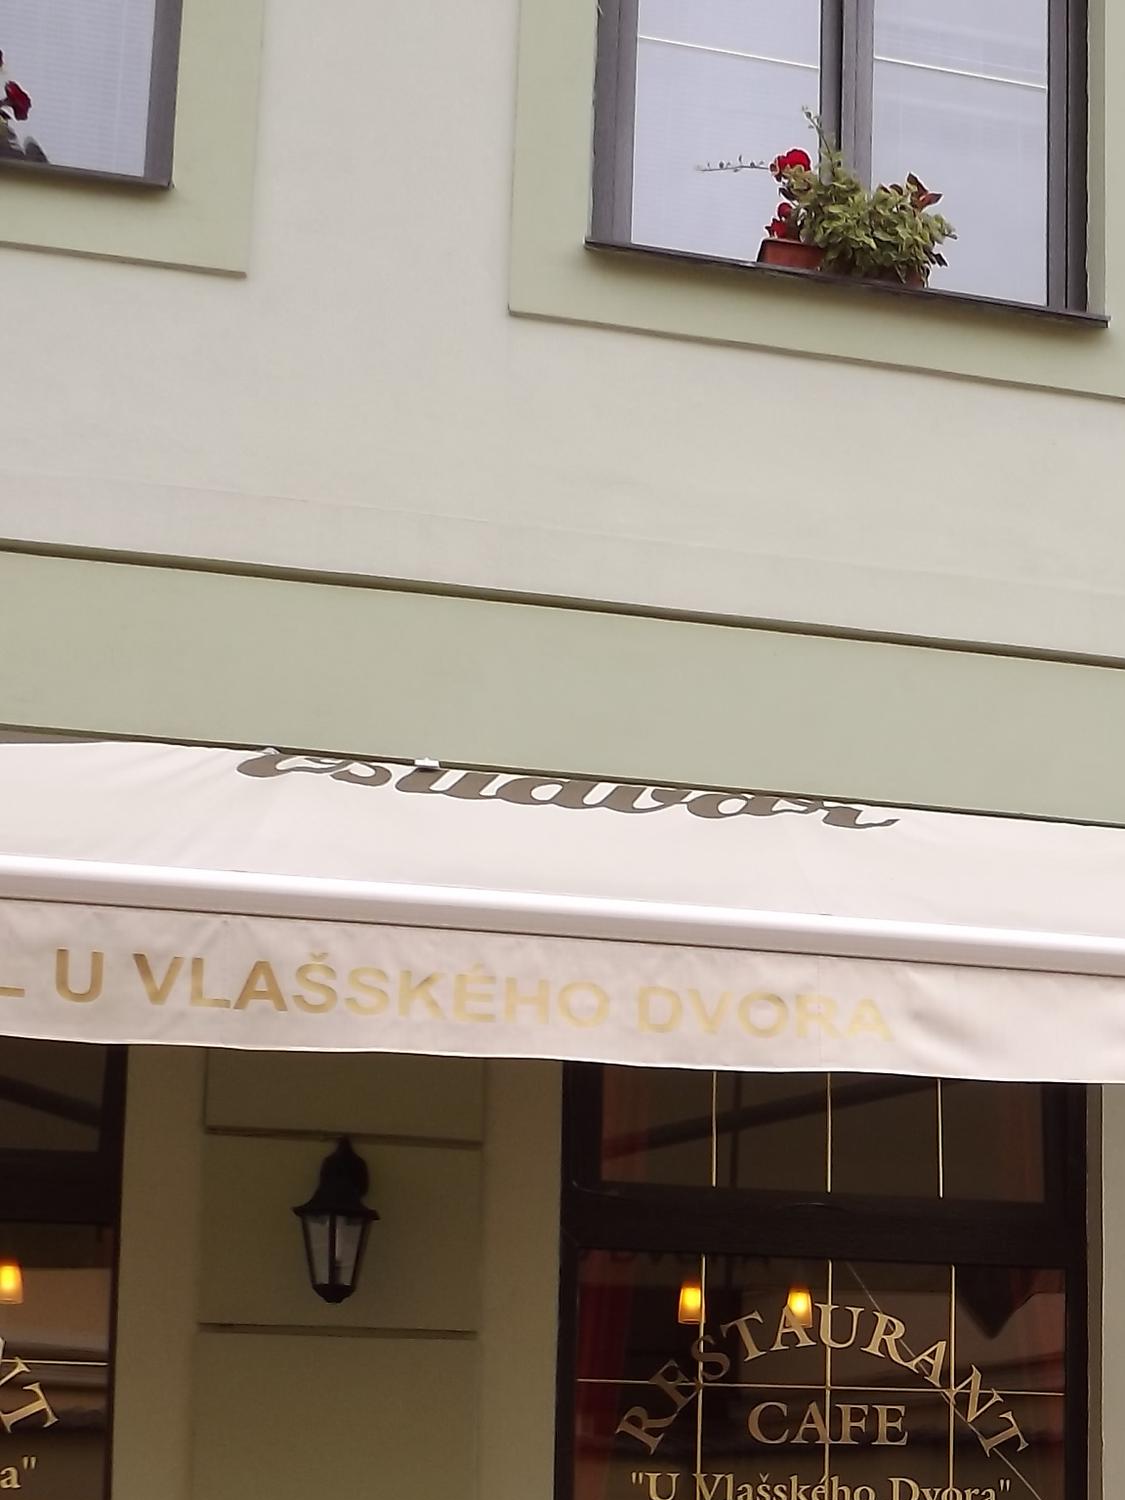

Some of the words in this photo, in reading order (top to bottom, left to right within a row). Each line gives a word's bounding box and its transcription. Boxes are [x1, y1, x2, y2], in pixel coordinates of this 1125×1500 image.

[132, 951, 609, 1028] VLAŠSKÉHO
[638, 988, 897, 1040] DVORA
[615, 1303, 1028, 1457] RESTAURANT
[747, 1401, 908, 1447] CAFE
